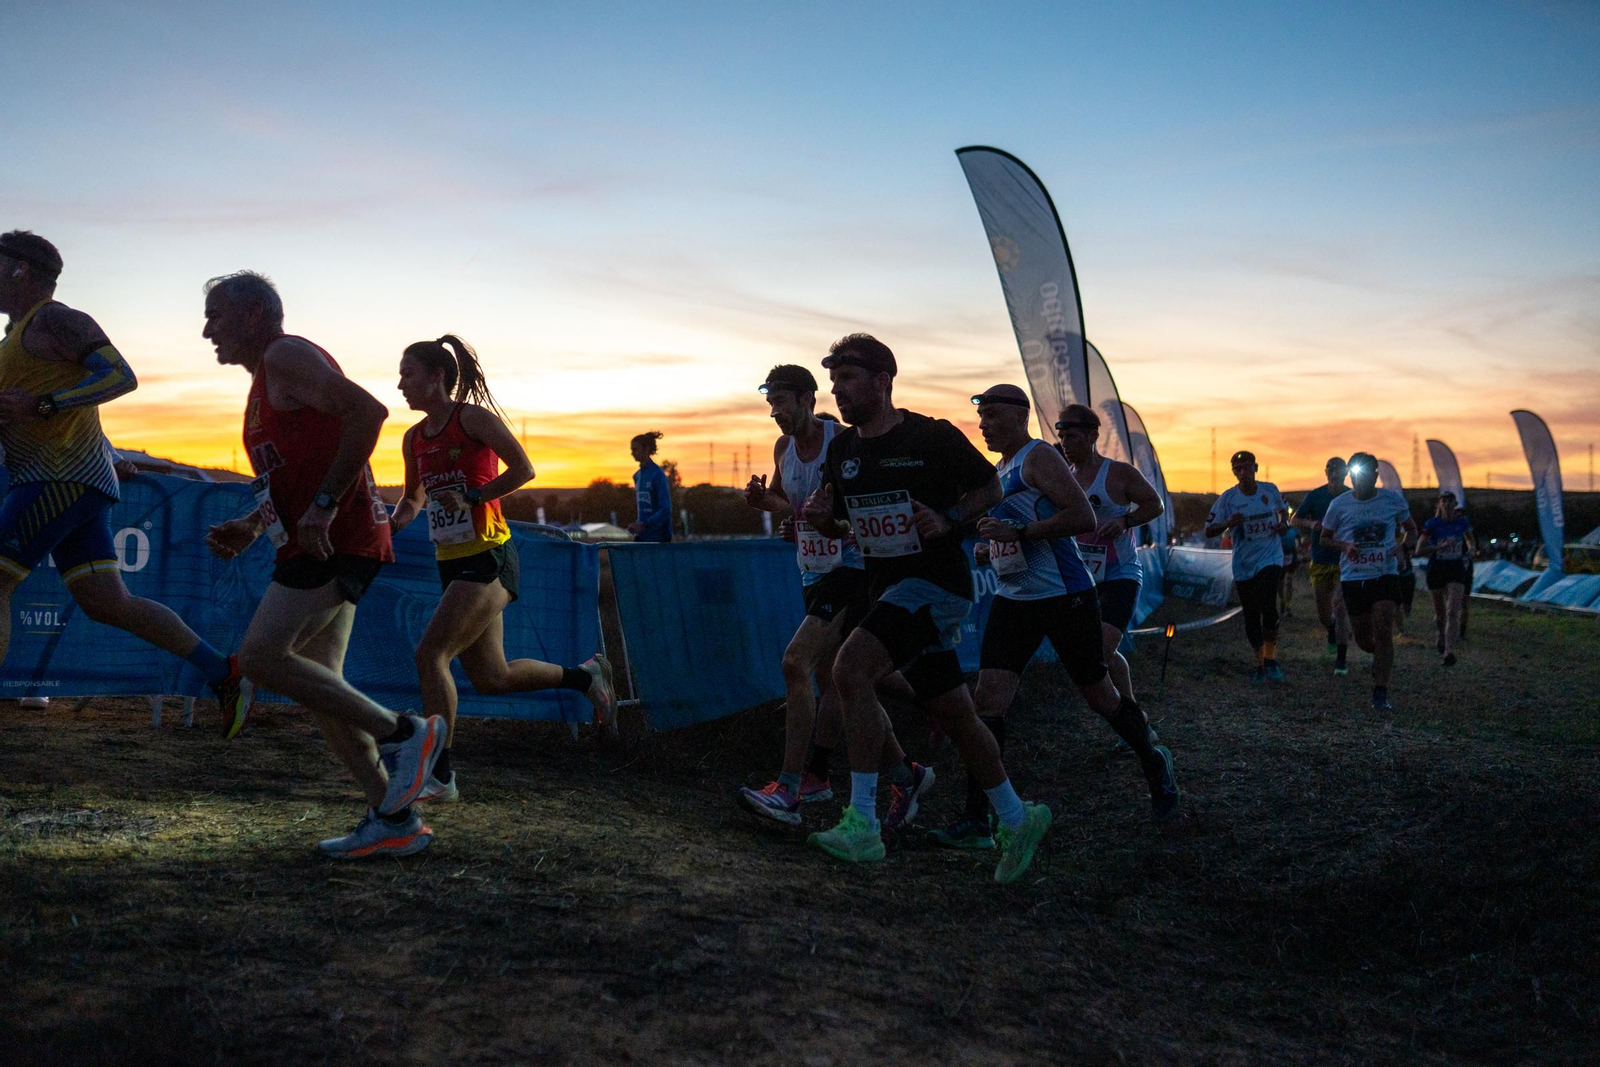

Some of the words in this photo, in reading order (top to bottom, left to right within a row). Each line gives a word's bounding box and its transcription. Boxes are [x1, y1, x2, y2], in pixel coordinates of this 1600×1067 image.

[430, 509, 468, 530] 3692
[856, 512, 911, 538] 3063
[801, 539, 838, 556] 3416
[2, 680, 61, 688] RESPONSABLE
